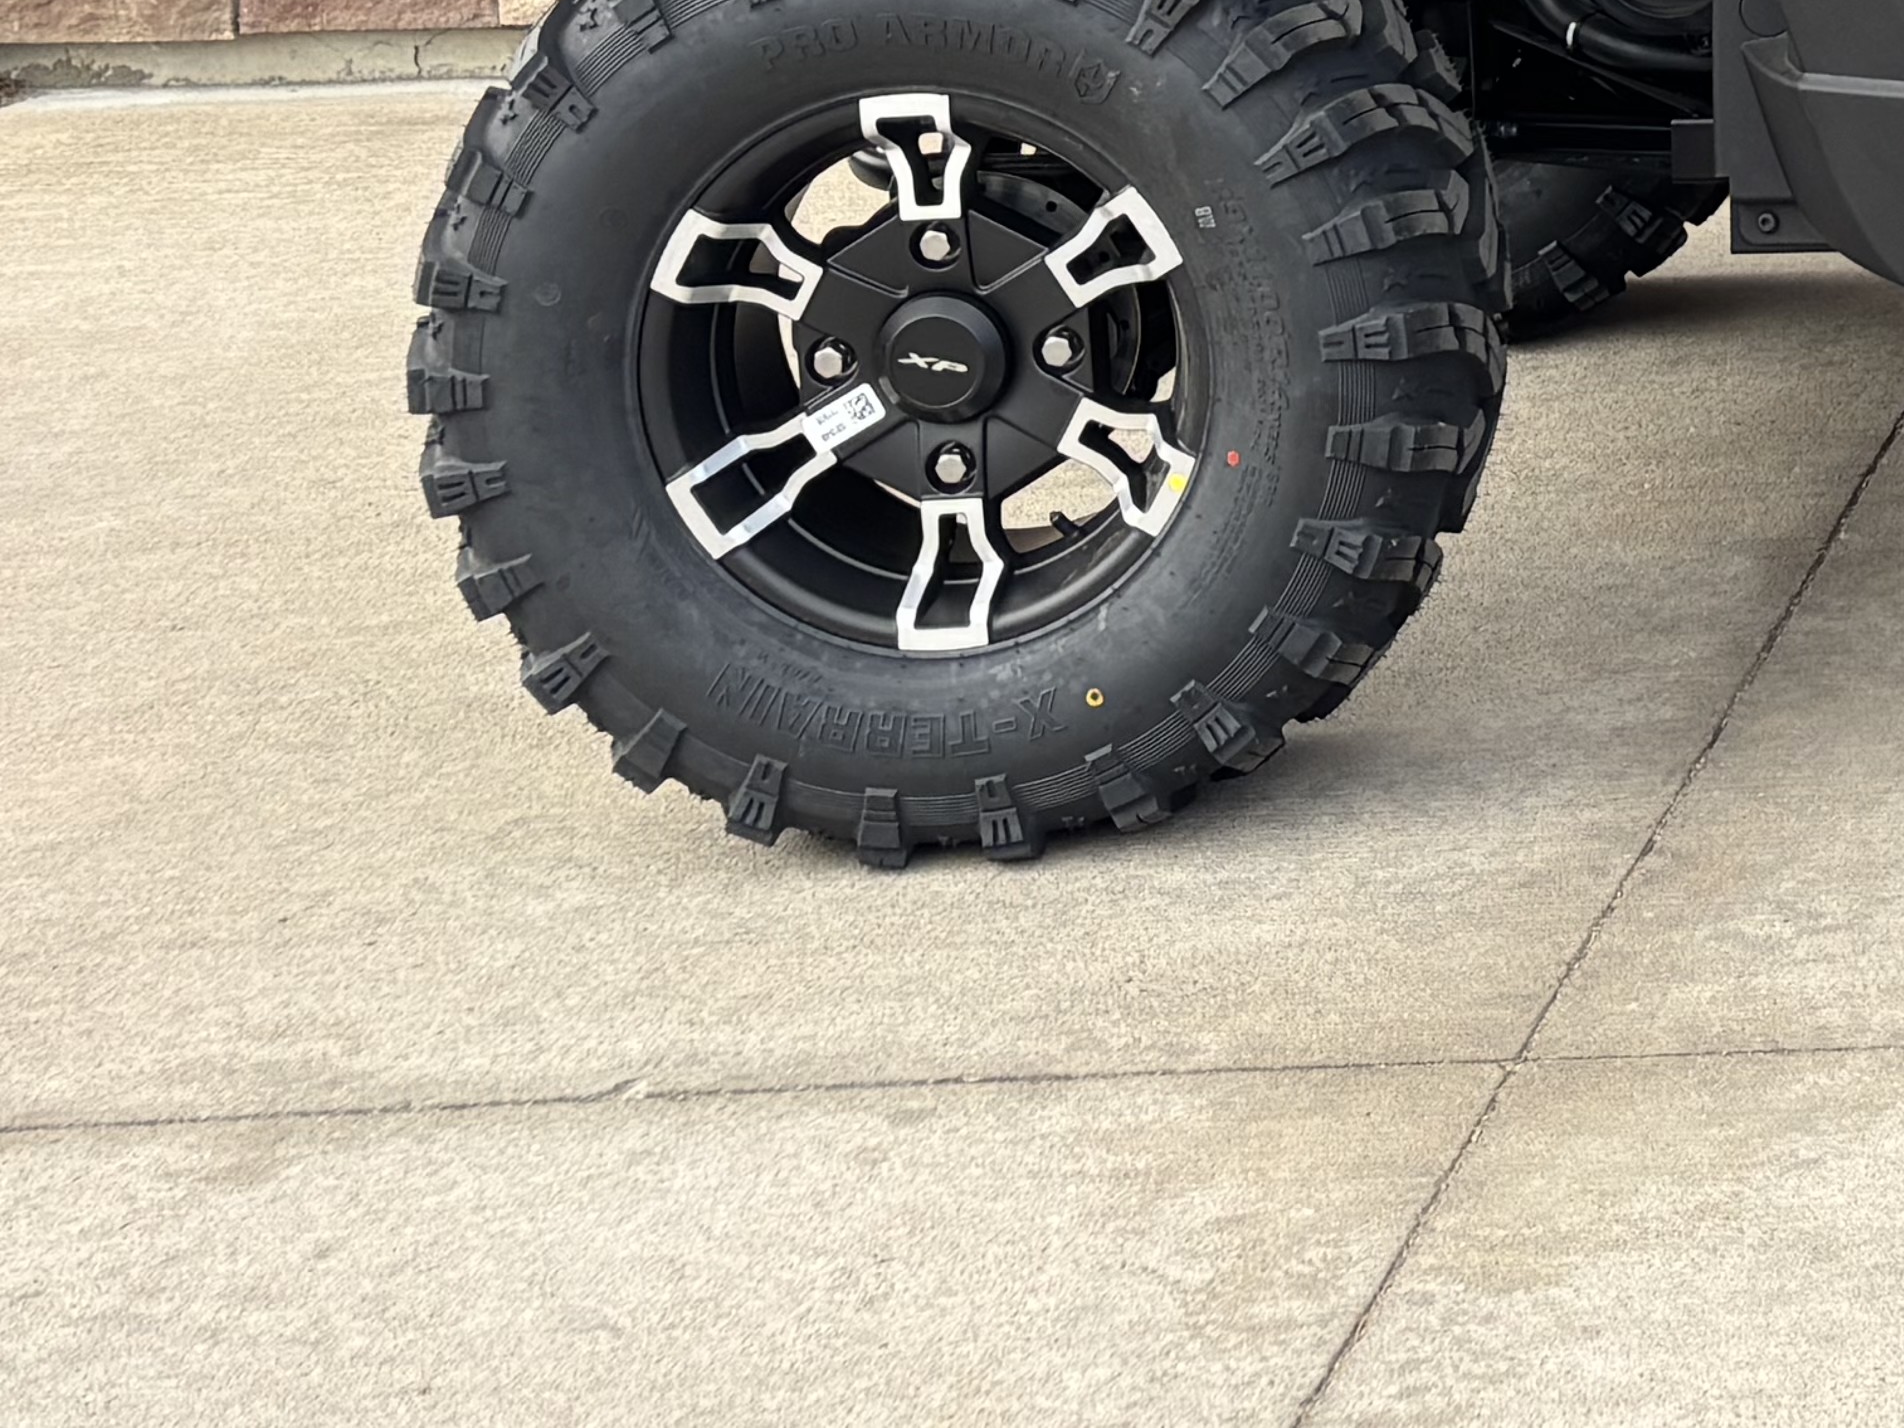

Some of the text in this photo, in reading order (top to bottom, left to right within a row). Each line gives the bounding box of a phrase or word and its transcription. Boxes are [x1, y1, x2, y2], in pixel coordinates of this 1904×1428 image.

[749, 12, 1070, 79] PRO ARMOR
[897, 352, 968, 372] XP
[705, 663, 1068, 758] X-TERRAIN
